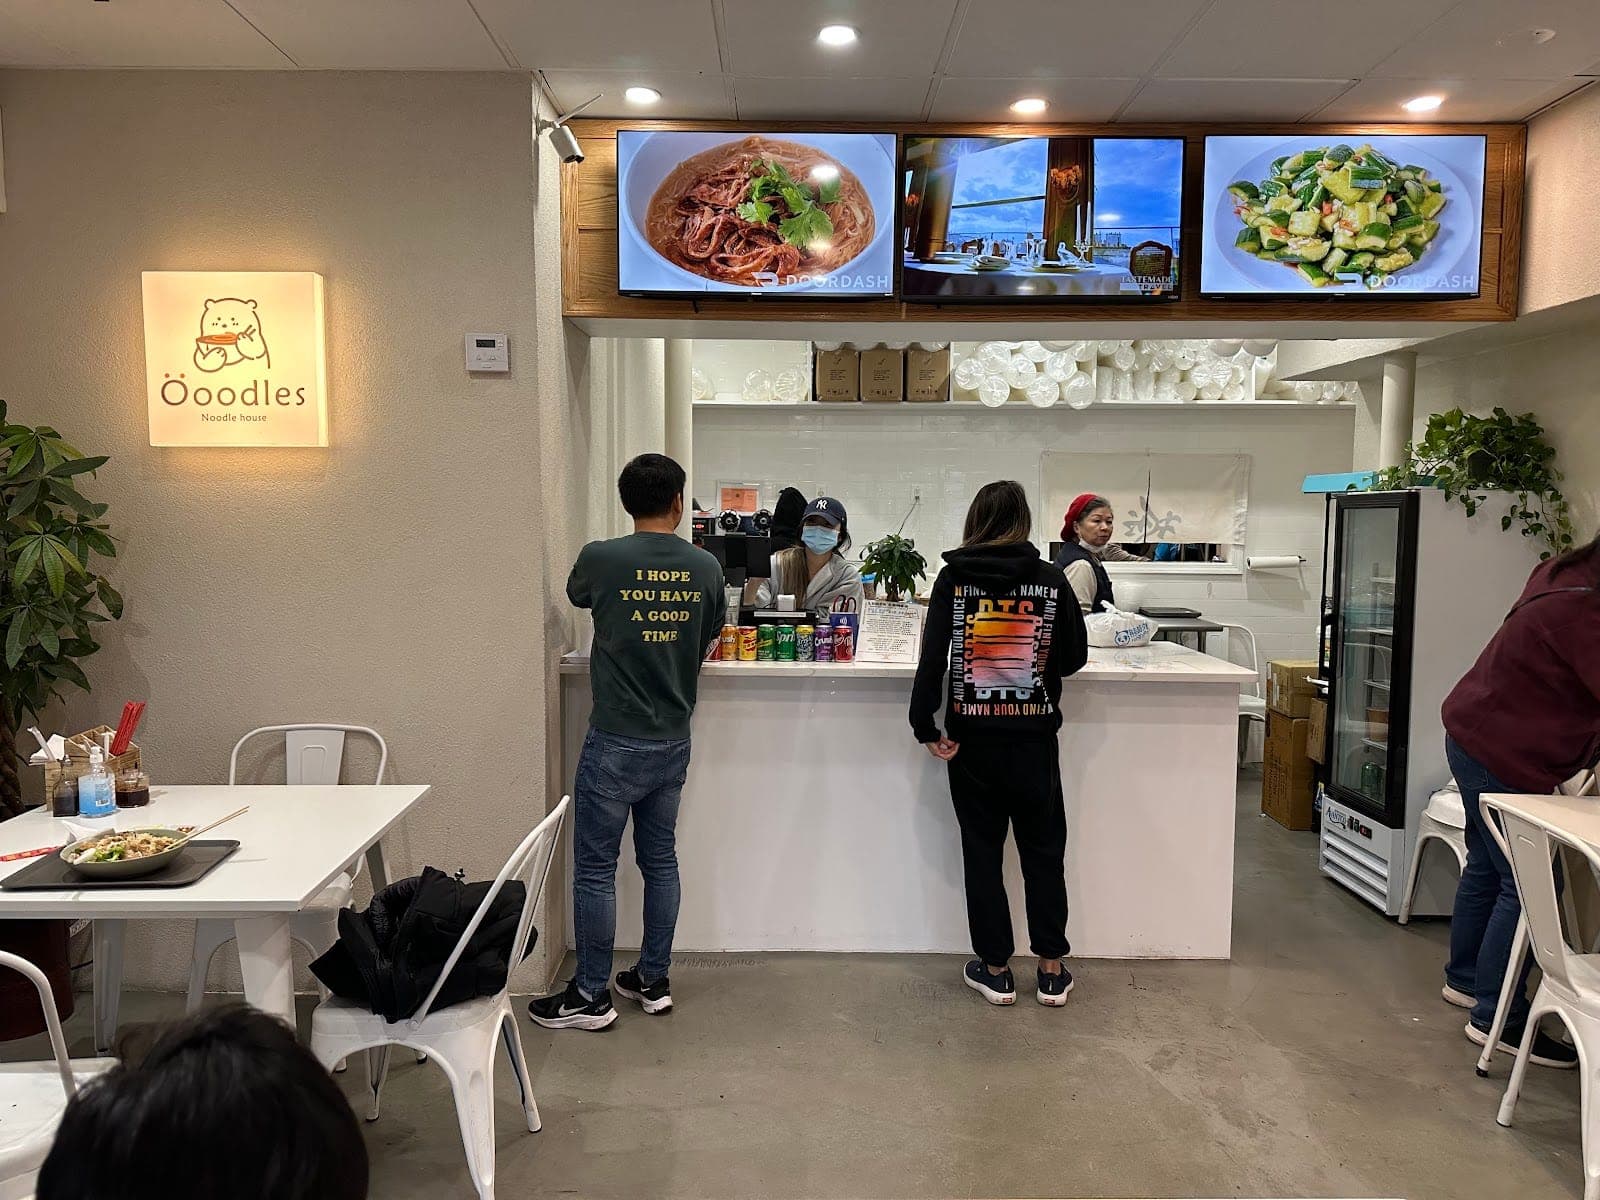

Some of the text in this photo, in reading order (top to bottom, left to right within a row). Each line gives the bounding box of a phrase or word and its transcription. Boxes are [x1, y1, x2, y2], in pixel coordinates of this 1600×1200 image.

[786, 275, 888, 288] DOORDASH
[160, 373, 305, 406] Öoodles
[201, 413, 268, 422] Noodle house
[636, 569, 691, 581] I HOPE
[620, 589, 702, 602] YOU HAVE
[1020, 584, 1049, 598] NAME
[630, 609, 690, 622] A GOOD
[1043, 600, 1057, 621] AND
[642, 630, 678, 642] TIME
[1040, 623, 1053, 646] FIND
[952, 598, 966, 701] AND FIND YOUR VOICE
[961, 703, 1047, 716] FIND YOUR NAME
